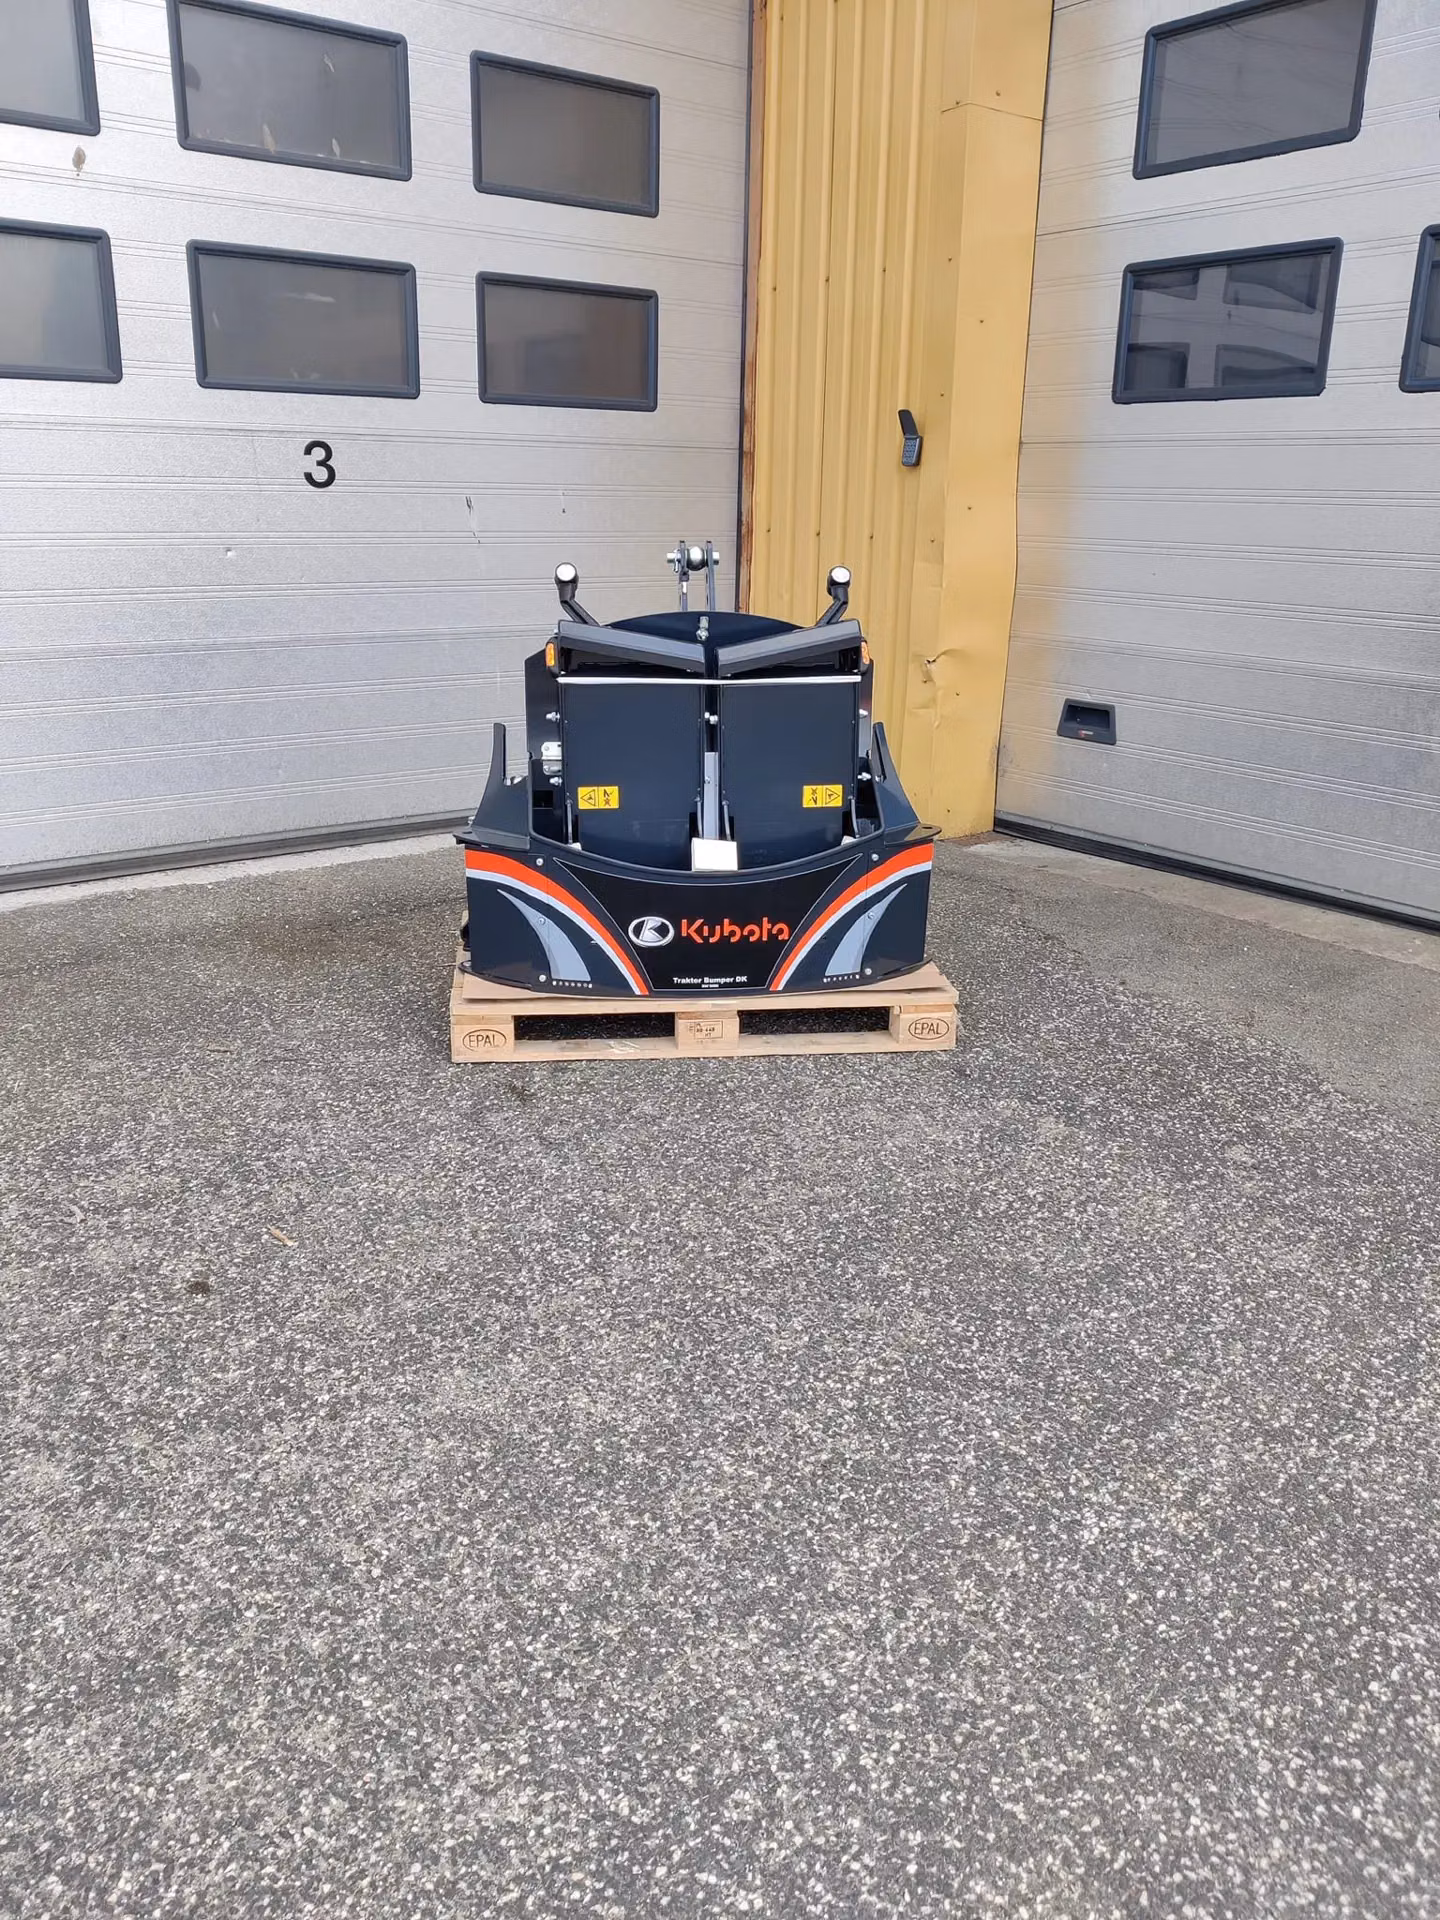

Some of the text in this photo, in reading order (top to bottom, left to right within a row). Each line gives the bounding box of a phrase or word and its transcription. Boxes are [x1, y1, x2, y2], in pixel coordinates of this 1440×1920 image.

[303, 440, 336, 489] 3
[681, 916, 790, 943] Kubota
[703, 976, 734, 985] Bumper
[735, 975, 748, 983] DK
[914, 1022, 943, 1035] EPAL
[468, 1034, 500, 1048] EPAL
